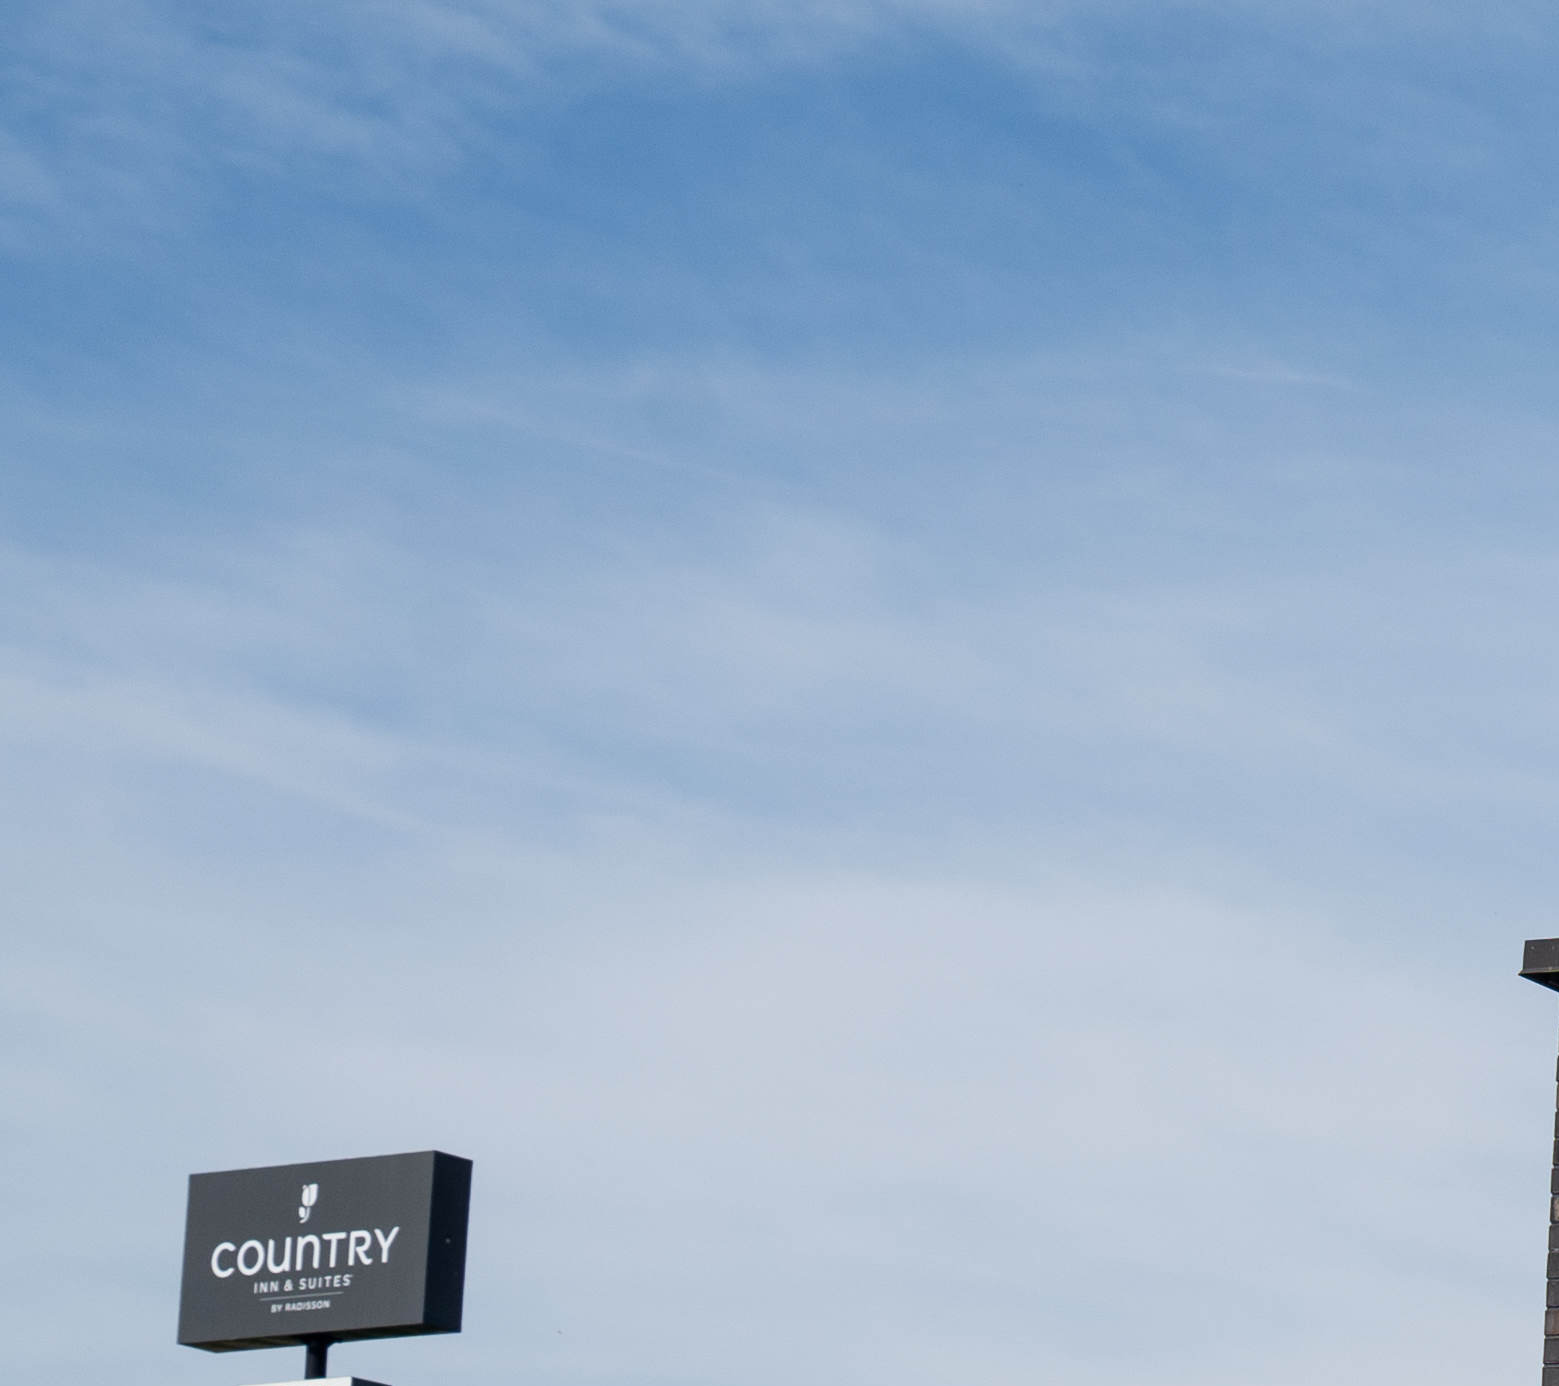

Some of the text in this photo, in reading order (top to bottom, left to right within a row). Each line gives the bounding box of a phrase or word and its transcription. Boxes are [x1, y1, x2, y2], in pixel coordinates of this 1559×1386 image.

[211, 1226, 400, 1278] COUNTRY
[253, 1274, 352, 1295] INN & SUITES
[270, 1300, 331, 1313] BY RADISSON
